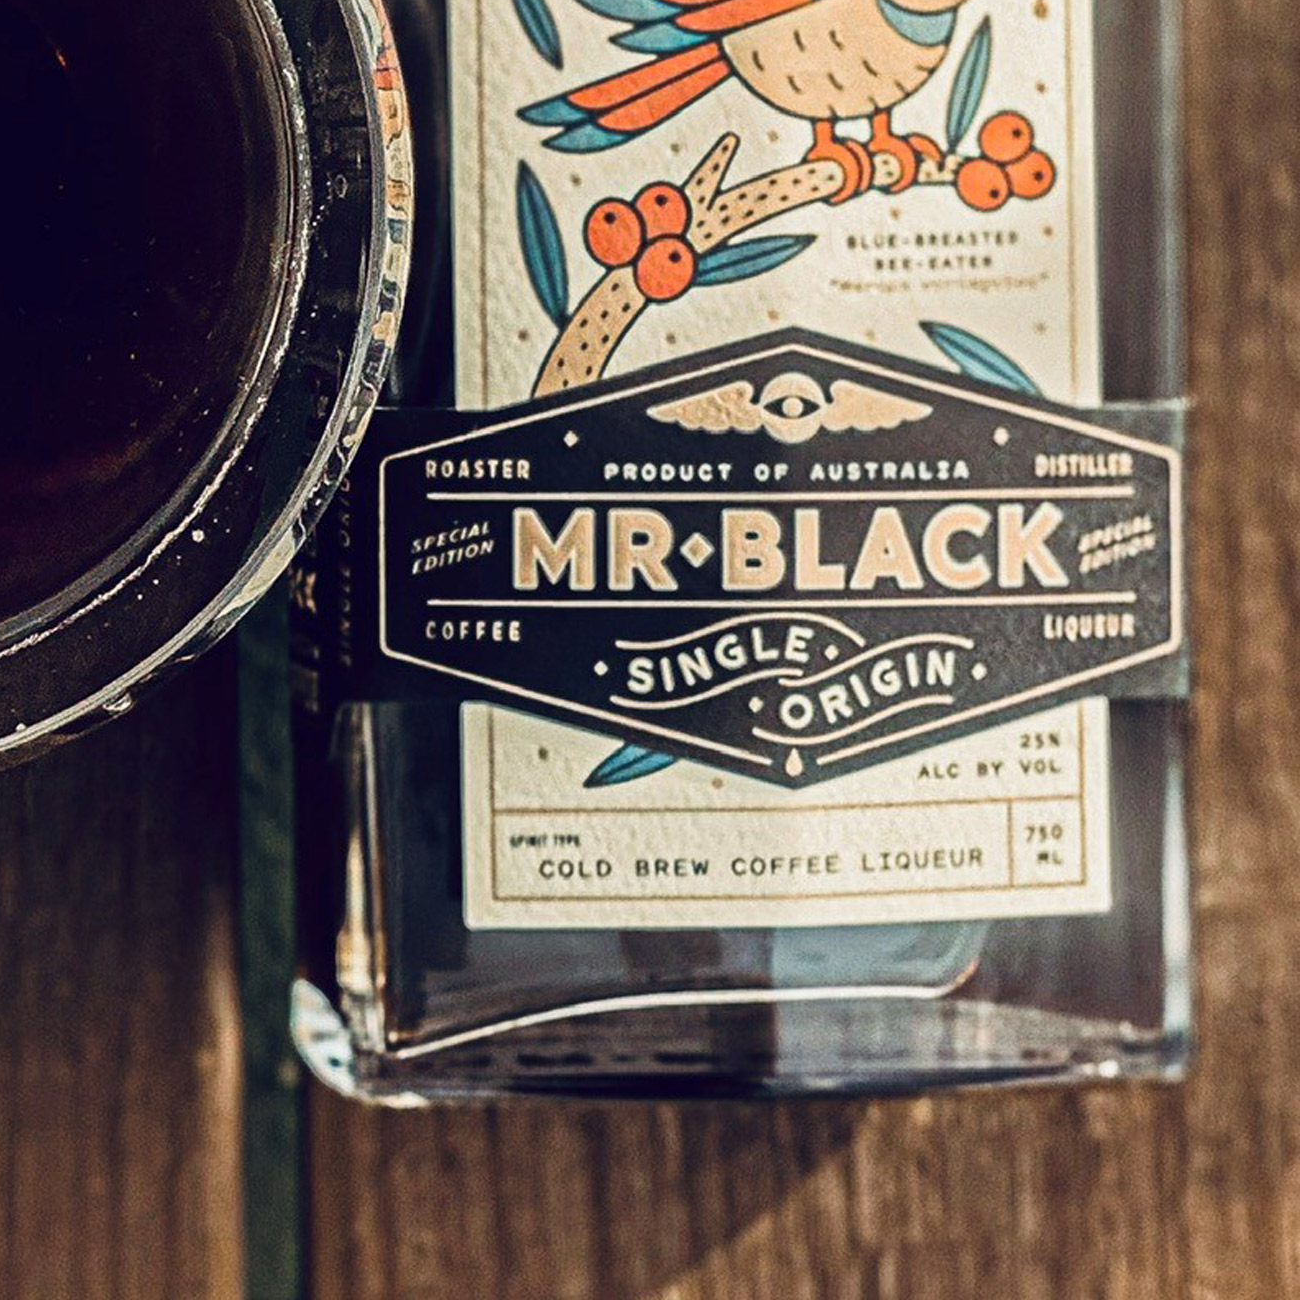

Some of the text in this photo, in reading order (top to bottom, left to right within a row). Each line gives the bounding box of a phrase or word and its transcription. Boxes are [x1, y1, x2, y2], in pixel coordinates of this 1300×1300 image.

[425, 458, 531, 480] ROASTER
[603, 459, 971, 482] PRODUCT OF AUSTRALIA
[1034, 452, 1134, 478] DISTILLER
[411, 520, 491, 554] SPECIAL
[511, 501, 1071, 591] MR BLACK
[411, 539, 494, 575] EDITION
[425, 620, 522, 642] COFFEE
[1043, 612, 1137, 642] LIQUEUR
[626, 625, 814, 694] SINGLE
[779, 648, 956, 730] ORIGIN
[1019, 733, 1061, 749] 25%
[917, 759, 1061, 780] ALC BY VOL
[1025, 824, 1063, 842] 750
[538, 847, 984, 879] COLD BREW COFFEE LIQUEUR
